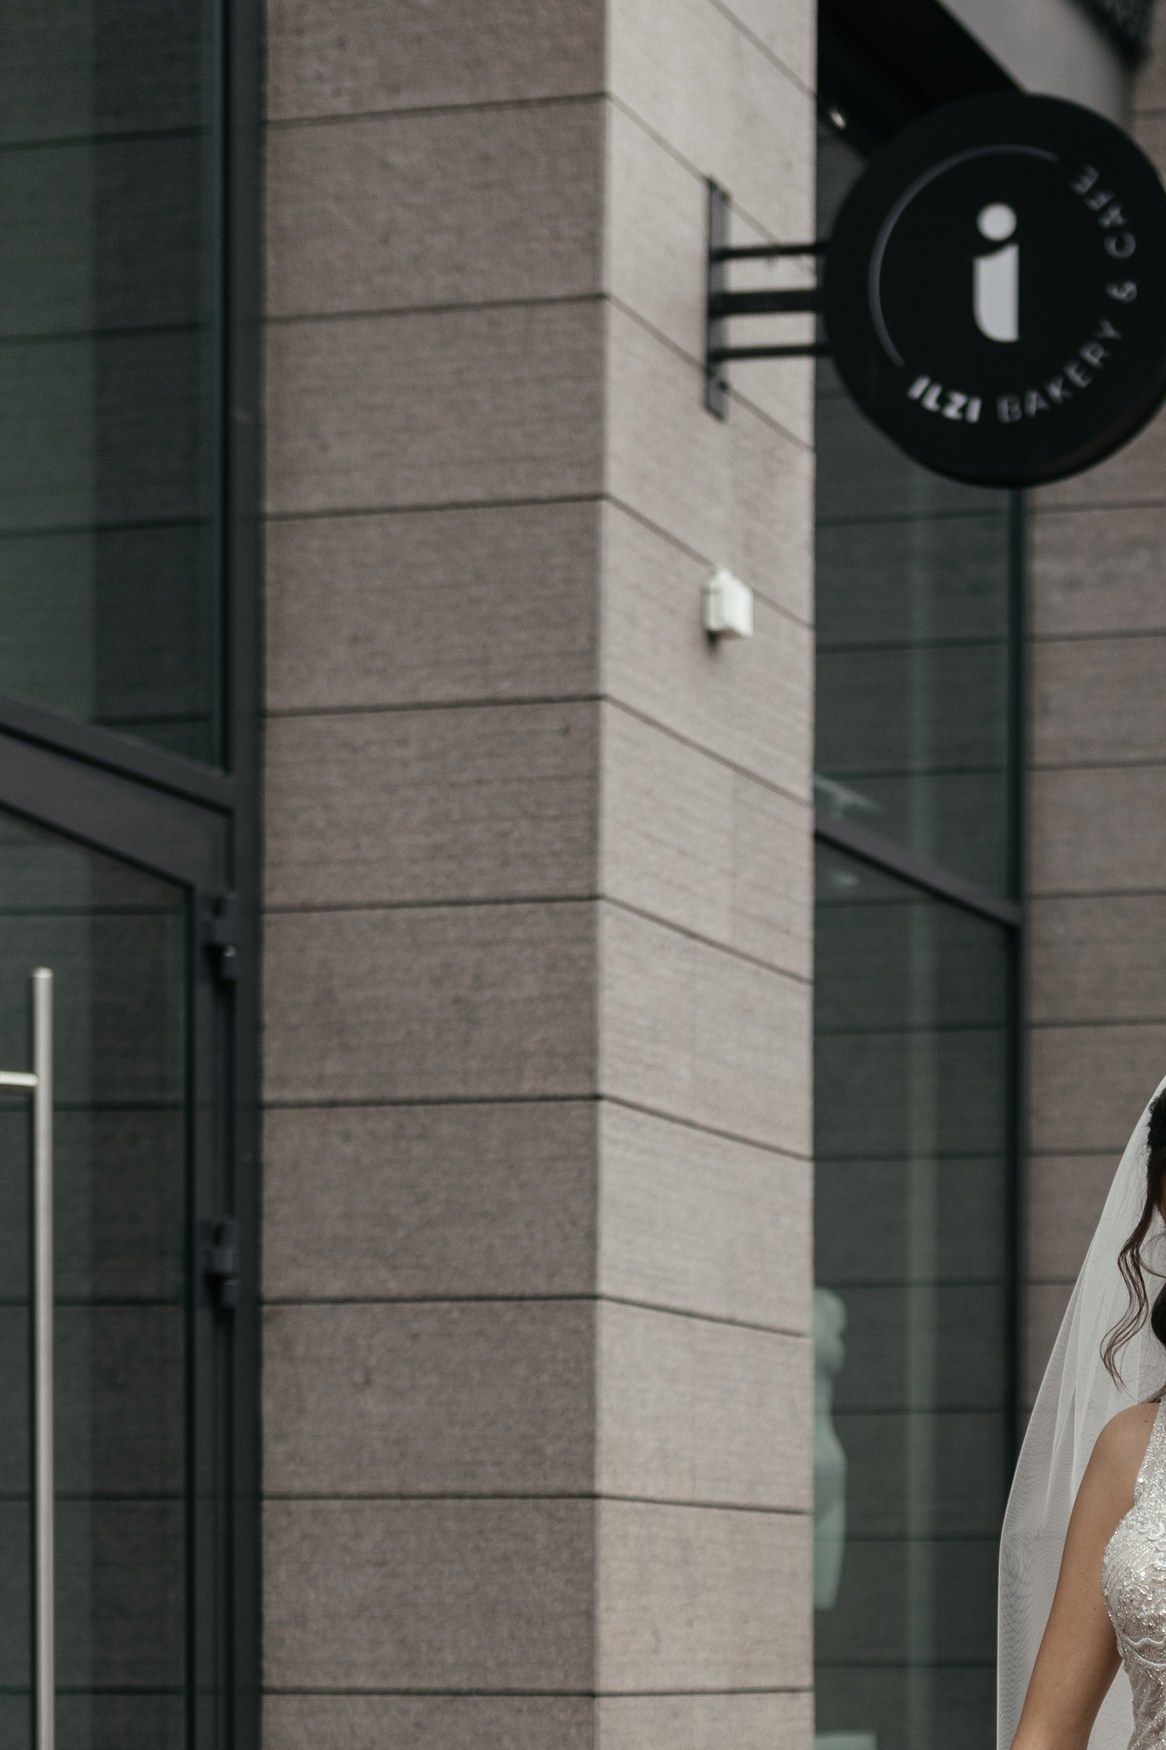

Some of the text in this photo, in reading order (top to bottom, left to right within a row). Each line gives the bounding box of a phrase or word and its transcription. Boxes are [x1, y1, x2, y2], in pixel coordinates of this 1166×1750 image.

[906, 374, 982, 424] ILZI
[996, 318, 1123, 424] BAKERY
[1068, 164, 1137, 260] CAFE
